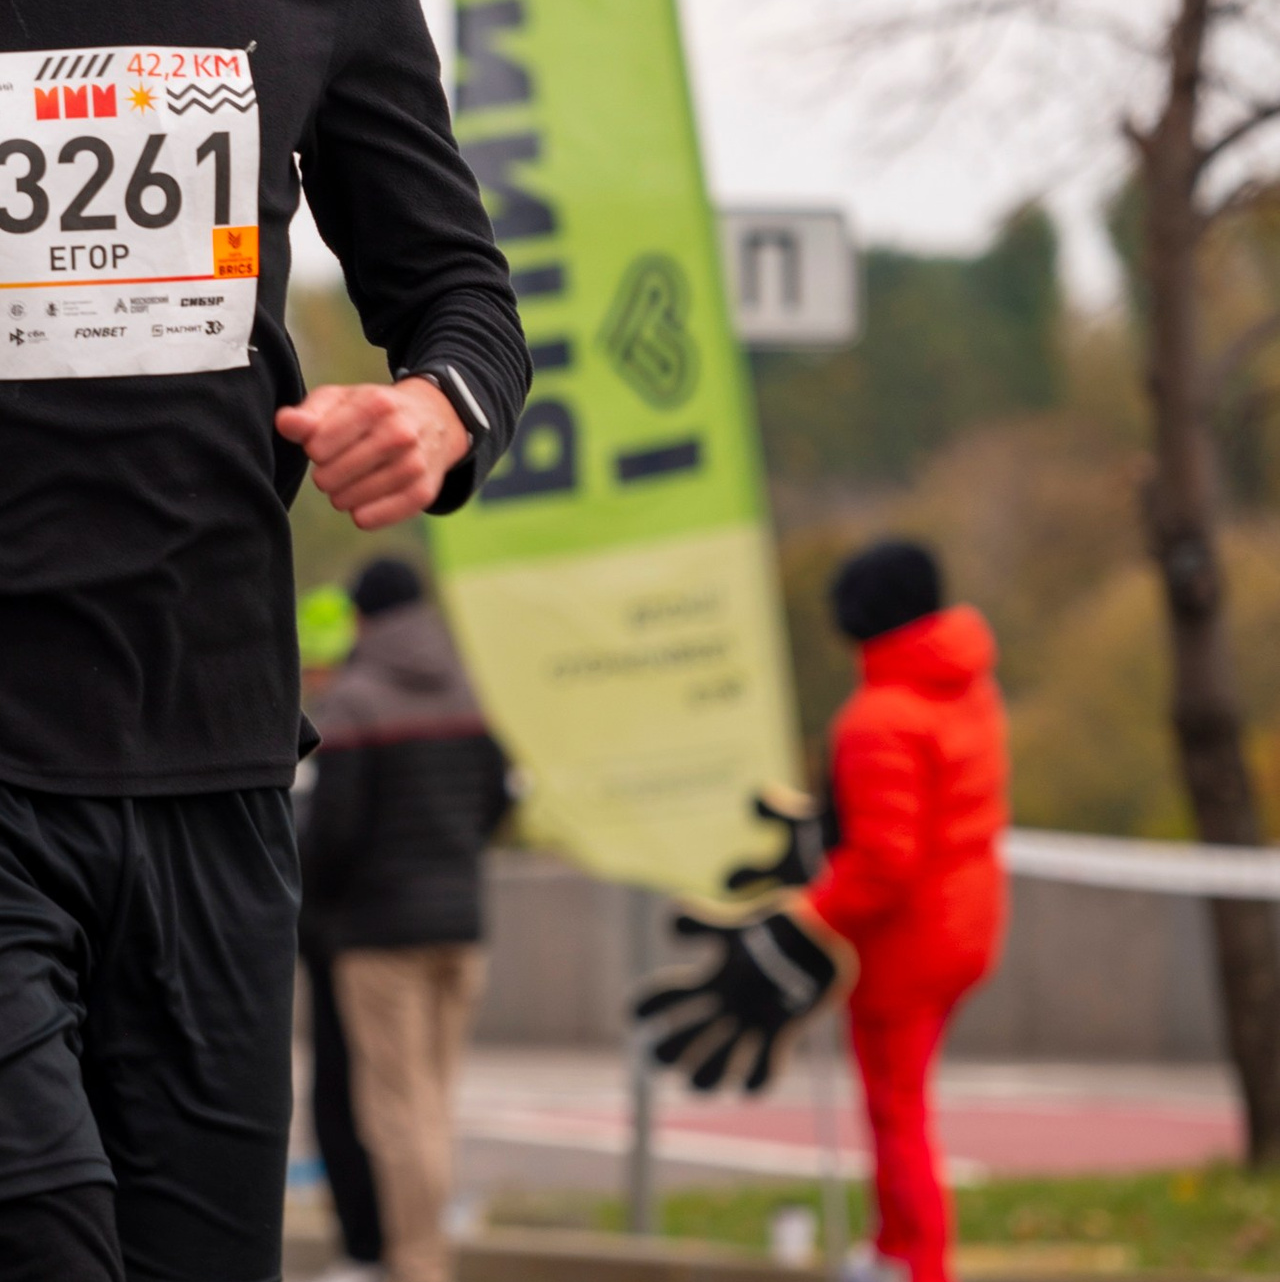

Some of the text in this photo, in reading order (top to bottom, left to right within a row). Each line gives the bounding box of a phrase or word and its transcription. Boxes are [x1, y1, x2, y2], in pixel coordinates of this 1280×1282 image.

[126, 53, 187, 81] 42,2
[50, 244, 130, 271] ЕГОР
[219, 263, 253, 276] BRICS
[180, 296, 224, 307] СИБУР
[74, 326, 127, 338] FONBET
[166, 324, 202, 334] МАГНИТ
